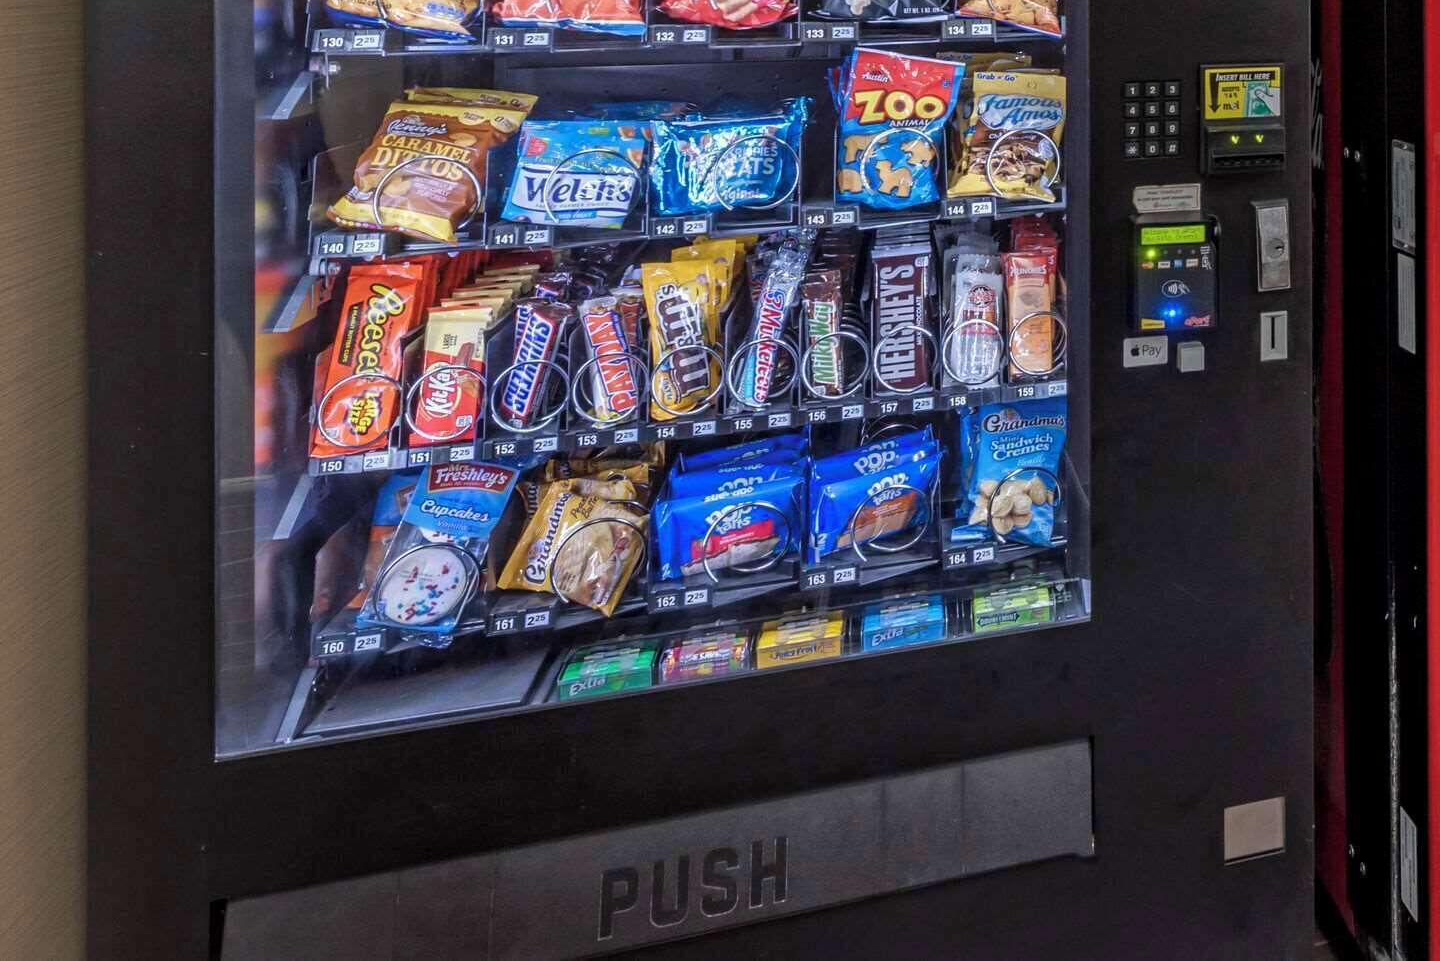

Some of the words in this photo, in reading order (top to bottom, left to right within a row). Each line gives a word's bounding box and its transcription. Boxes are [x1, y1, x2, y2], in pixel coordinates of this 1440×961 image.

[806, 29, 825, 39] 133
[947, 26, 965, 35] 134
[495, 35, 514, 46] 131
[655, 31, 675, 42] 132
[321, 37, 344, 48] 130
[861, 71, 890, 83] Austin
[976, 72, 996, 81] Grab
[1004, 74, 1016, 82] Go
[1216, 72, 1239, 82] INSERT
[1238, 73, 1253, 81] BILL
[1254, 72, 1272, 81] HERE
[1130, 87, 1136, 95] 1
[1149, 85, 1156, 95] 2
[1169, 85, 1176, 94] 3
[854, 89, 946, 125] ZOO
[977, 94, 1063, 116] Famous
[1129, 106, 1136, 115] 4
[1149, 105, 1156, 114] 5
[1169, 104, 1176, 113] 6
[991, 107, 1061, 129] Amos
[1129, 126, 1136, 135] 7
[1149, 125, 1156, 134] 8
[1169, 124, 1176, 134] 9
[381, 134, 473, 164] CARAMEL
[1149, 145, 1156, 154] 0
[524, 175, 634, 204] Welch's
[948, 205, 965, 215] 144
[807, 215, 825, 225] 143
[656, 224, 676, 235] 142
[495, 234, 515, 245] 141
[322, 243, 344, 254] 140
[762, 289, 785, 310] 3
[914, 295, 923, 328] HOCOLATE
[878, 263, 916, 385] HERSHEY'S
[1141, 345, 1163, 359] Pay
[583, 310, 638, 414] PAYDAY
[1018, 387, 1034, 397] 159
[949, 396, 967, 407] 158
[355, 390, 381, 435] LARGE
[881, 402, 898, 413] 157
[349, 398, 362, 429] SIZE
[808, 410, 827, 421] 156
[734, 419, 753, 430] 155
[983, 414, 1066, 434] Grandma's
[656, 427, 675, 438] 154
[578, 435, 598, 445] 153
[990, 433, 1054, 451] Sandwich
[494, 443, 515, 455] 152
[992, 443, 1050, 462] Cremes
[410, 452, 430, 463] 151
[321, 460, 342, 472] 150
[434, 468, 509, 488] Freshley's
[420, 499, 490, 523] Cupcakes
[949, 554, 966, 565] 164
[807, 574, 826, 586] 163
[656, 597, 676, 608] 162
[495, 619, 515, 631] 161
[871, 628, 904, 647] Extra
[323, 641, 345, 654] 160
[568, 677, 607, 696] Extra
[597, 837, 789, 942] PUSH
